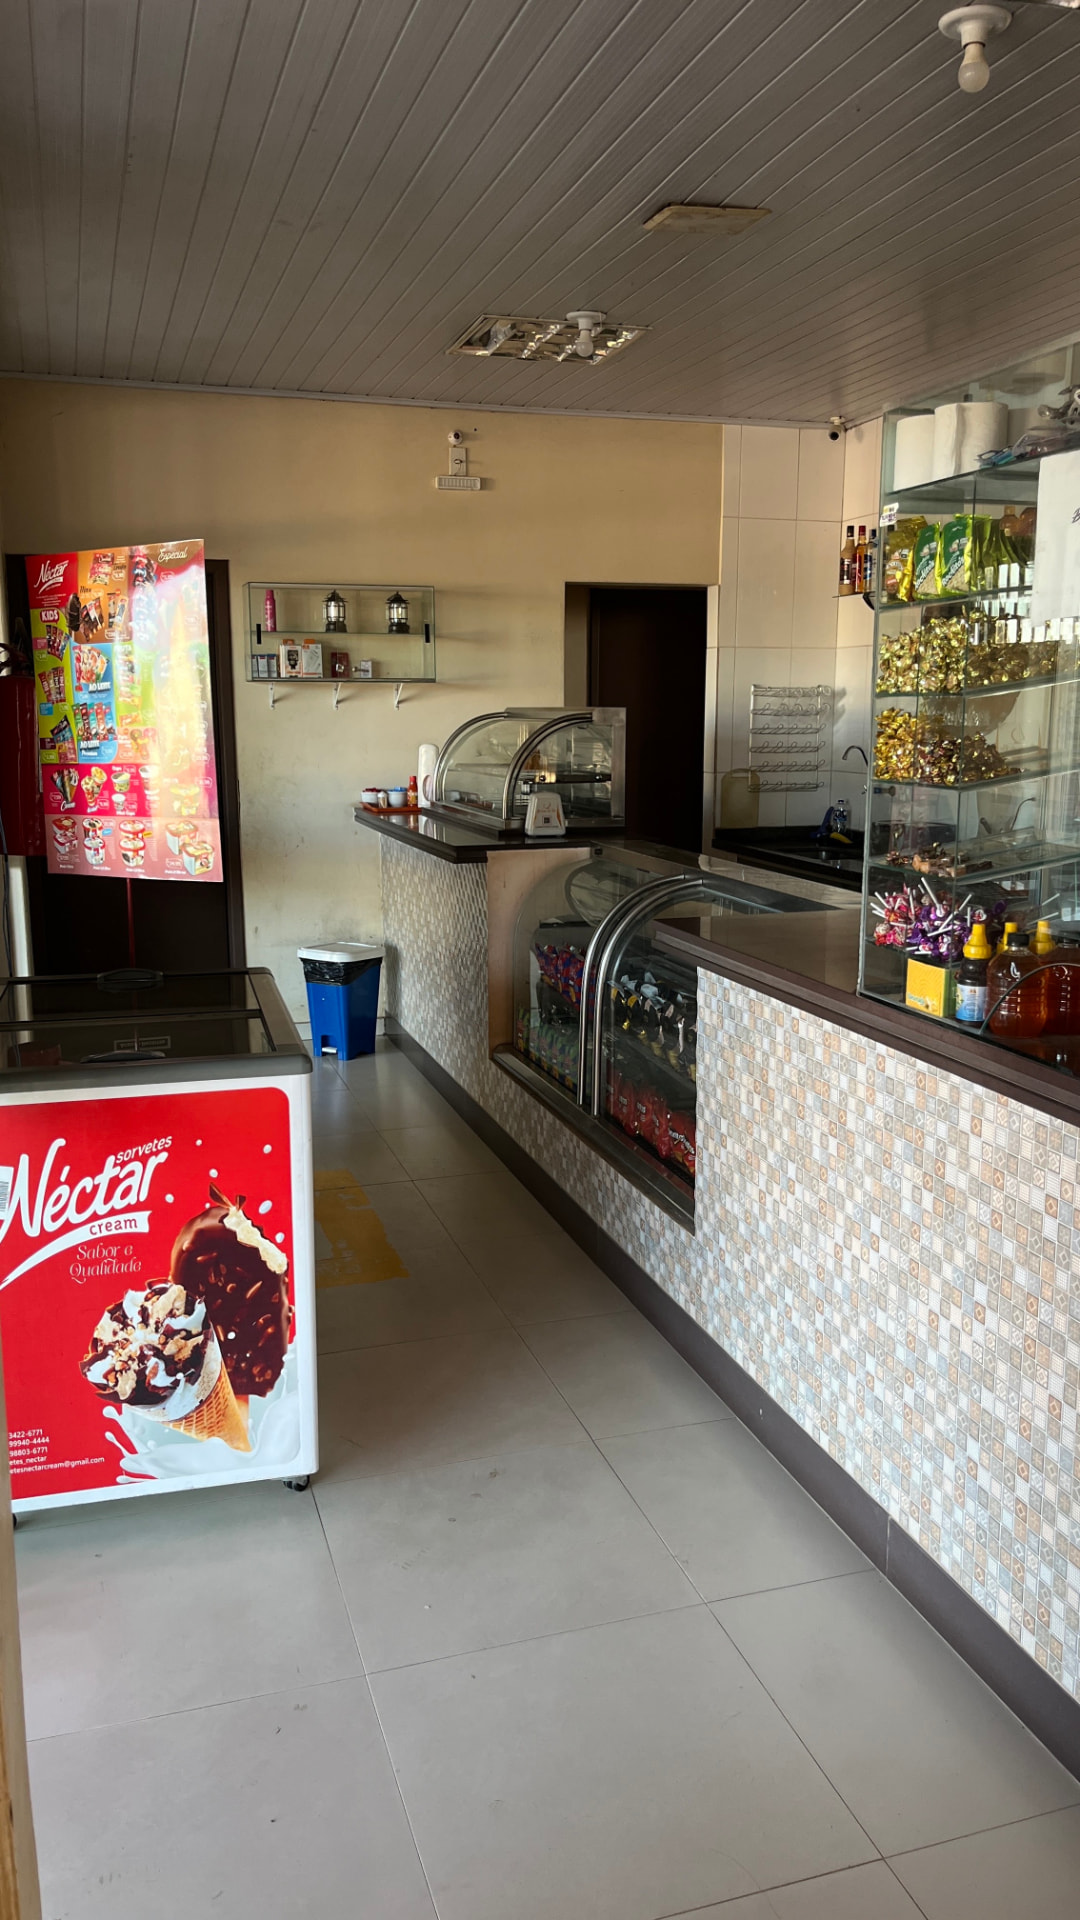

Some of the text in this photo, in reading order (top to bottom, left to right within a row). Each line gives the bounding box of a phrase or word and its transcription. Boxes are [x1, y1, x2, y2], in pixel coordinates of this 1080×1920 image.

[41, 610, 59, 622] KIDS
[116, 1135, 173, 1163] sorvetes
[0, 1137, 169, 1244] Néctar
[89, 1216, 138, 1236] cream
[76, 1242, 121, 1261] Sabor
[69, 1256, 143, 1284] Qualidade
